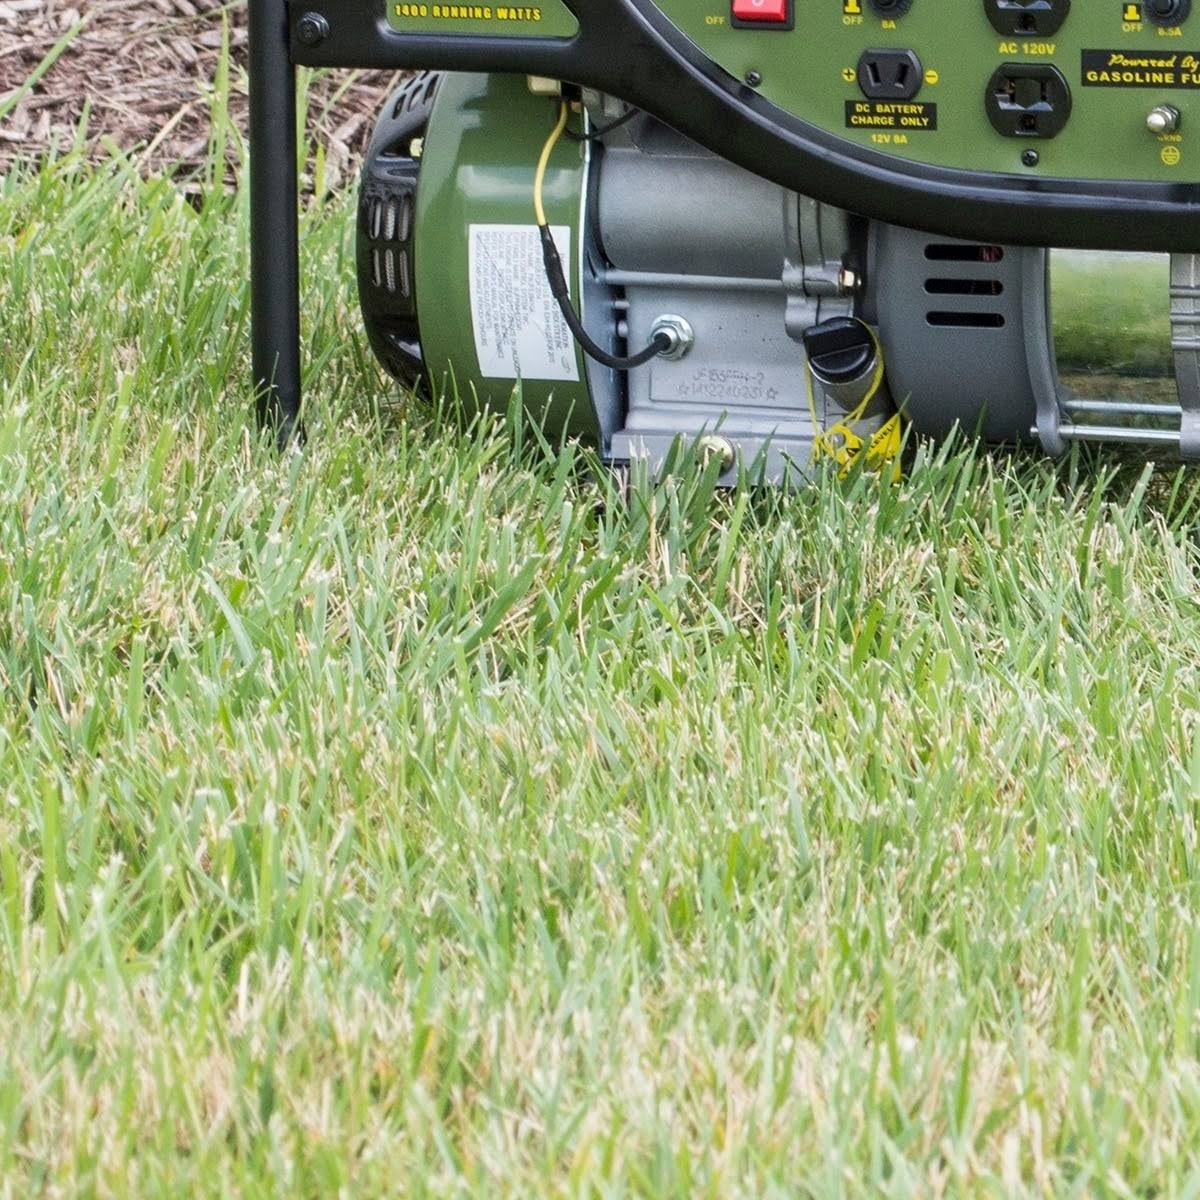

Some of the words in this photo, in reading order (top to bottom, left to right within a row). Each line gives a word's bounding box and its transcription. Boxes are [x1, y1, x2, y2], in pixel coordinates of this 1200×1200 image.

[395, 4, 428, 17] 1400
[432, 5, 492, 19] RUNNING
[496, 7, 541, 21] WATTS
[705, 16, 725, 25] OFF
[843, 16, 863, 25] OFF
[1122, 23, 1143, 32] OFF
[999, 42, 1018, 54] AC
[1023, 43, 1056, 55] 120V
[1108, 53, 1176, 68] Powered
[1181, 56, 1199, 72] By
[1087, 71, 1174, 84] GASOLINE
[856, 104, 869, 113] DC
[876, 104, 924, 114] BATTERY
[851, 116, 894, 125] CHARGE
[901, 117, 929, 126] ONLY
[871, 134, 891, 144] 12V
